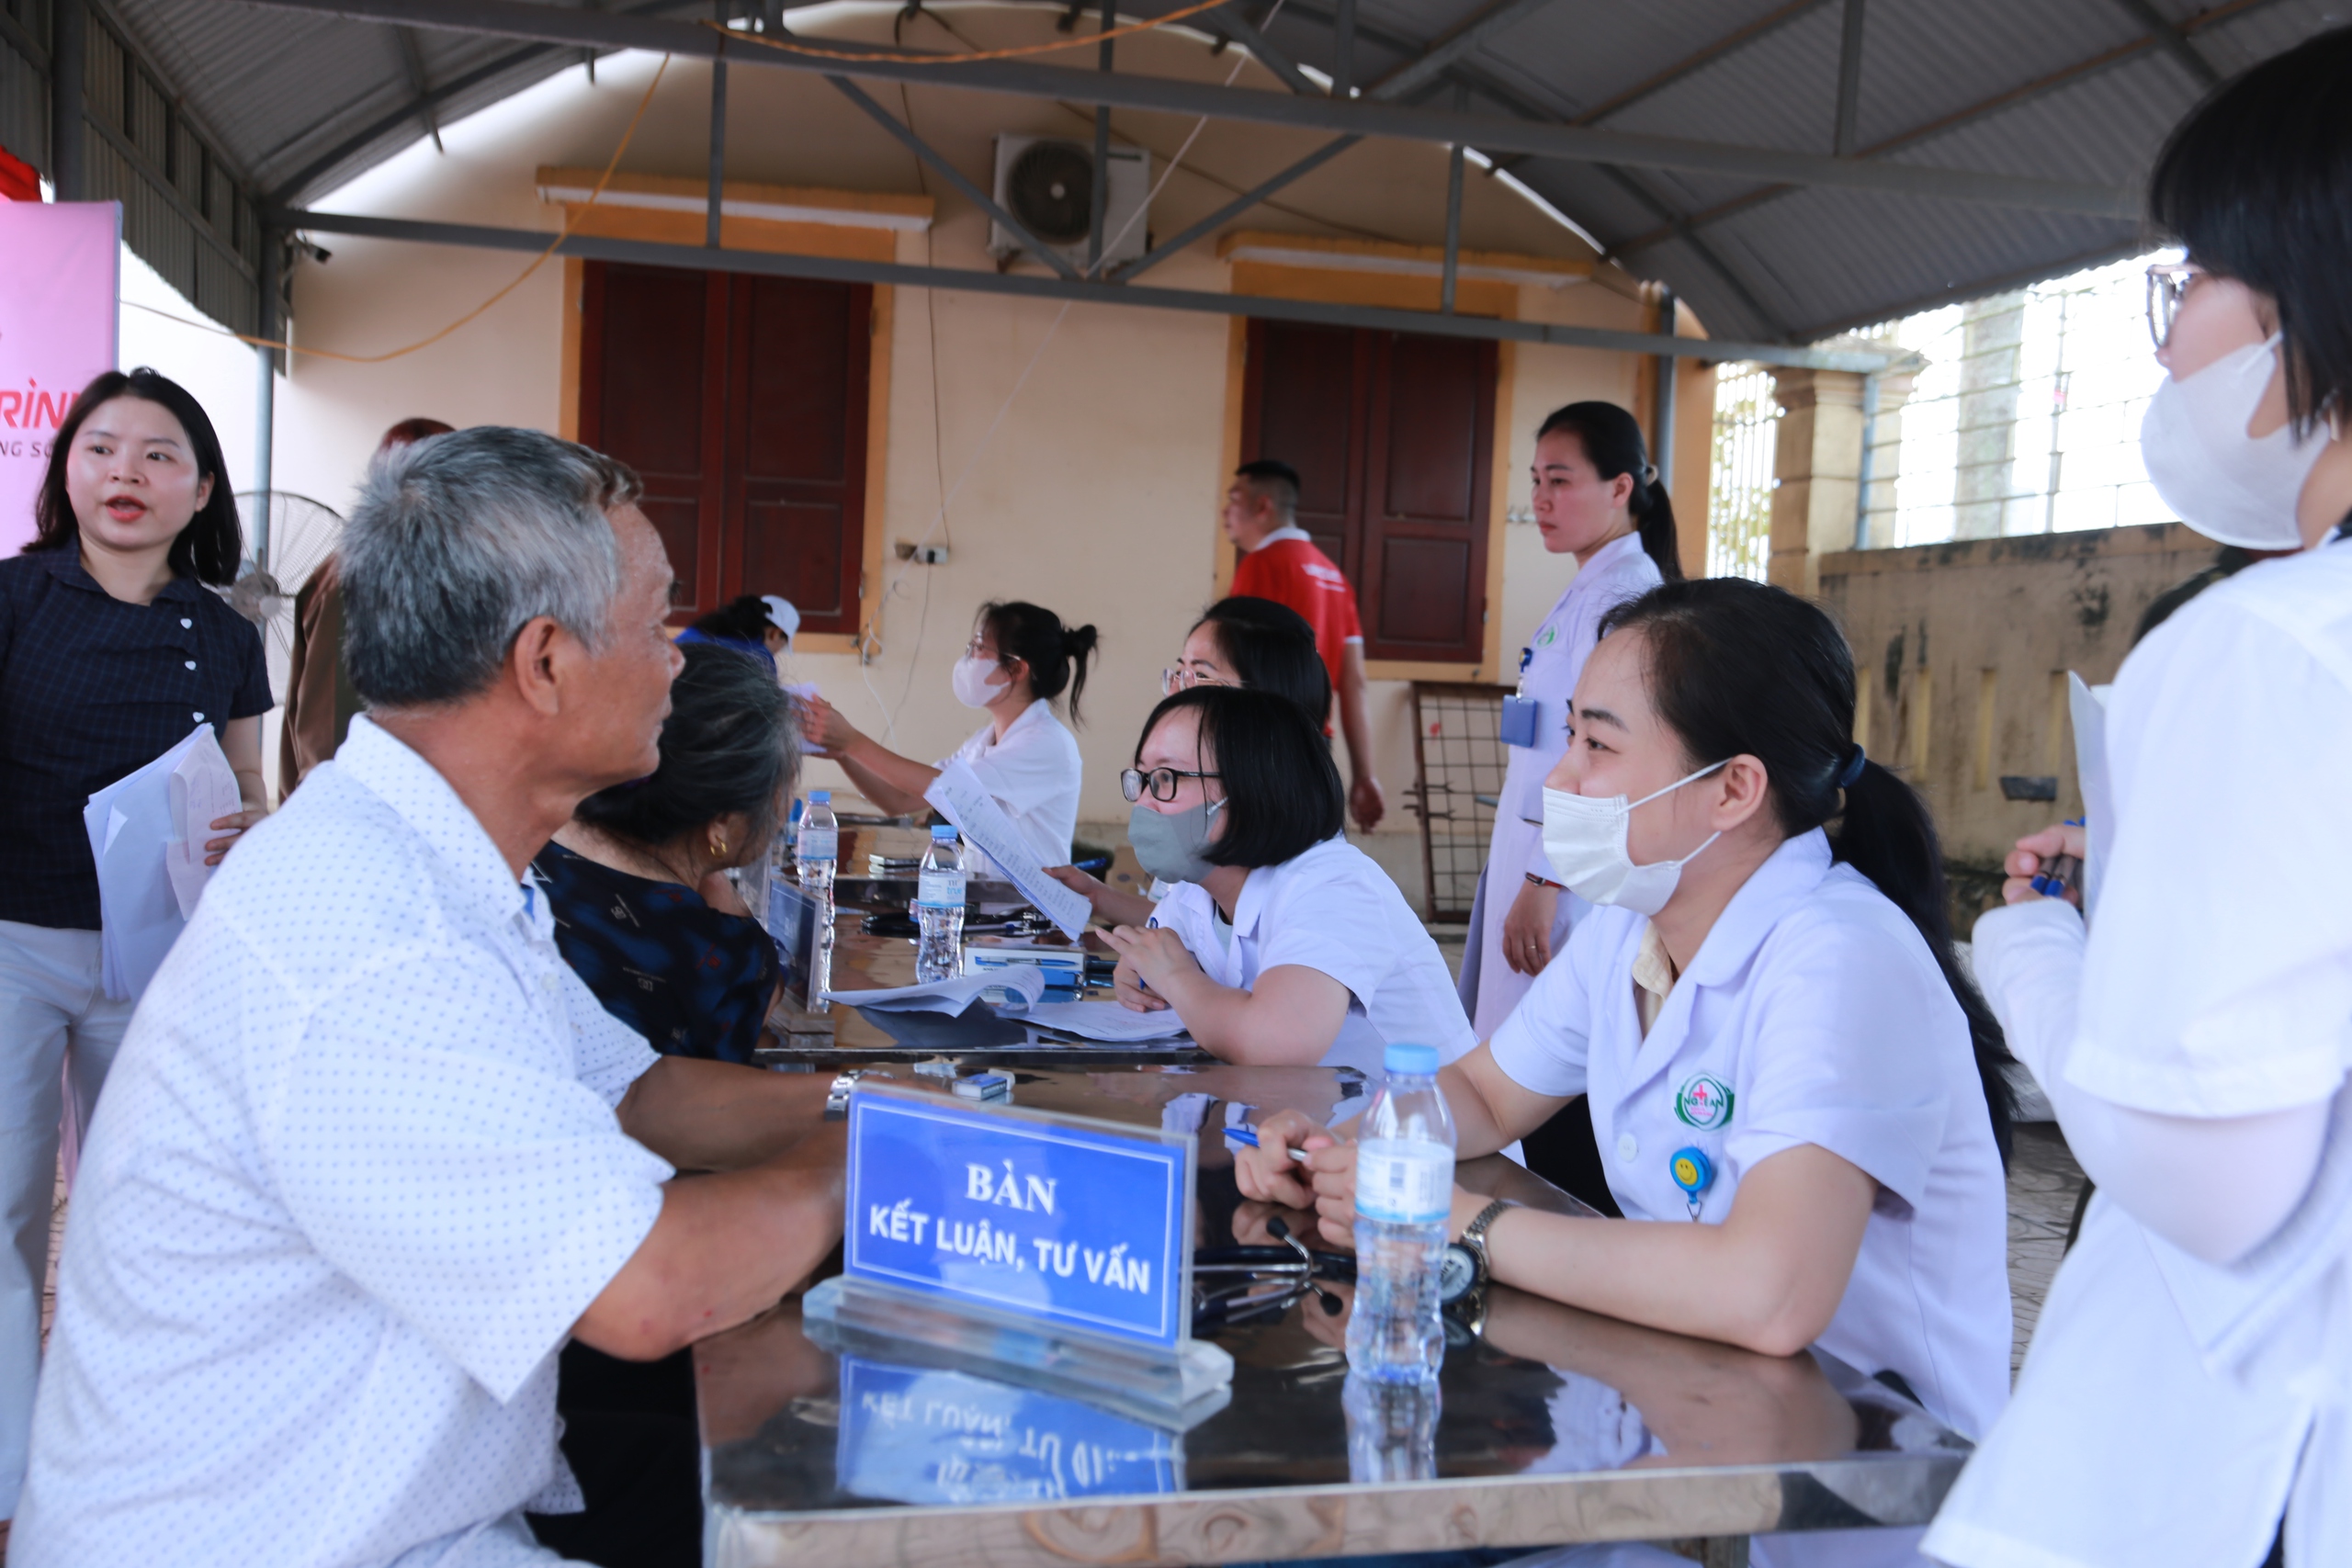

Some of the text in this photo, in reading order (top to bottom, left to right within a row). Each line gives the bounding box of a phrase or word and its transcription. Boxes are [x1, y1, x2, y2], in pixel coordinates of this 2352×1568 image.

[0, 377, 81, 429] RÌN
[966, 1159, 1057, 1215] BÀN
[869, 1199, 1150, 1294] KẾT LUẬN, TƯ VẤN
